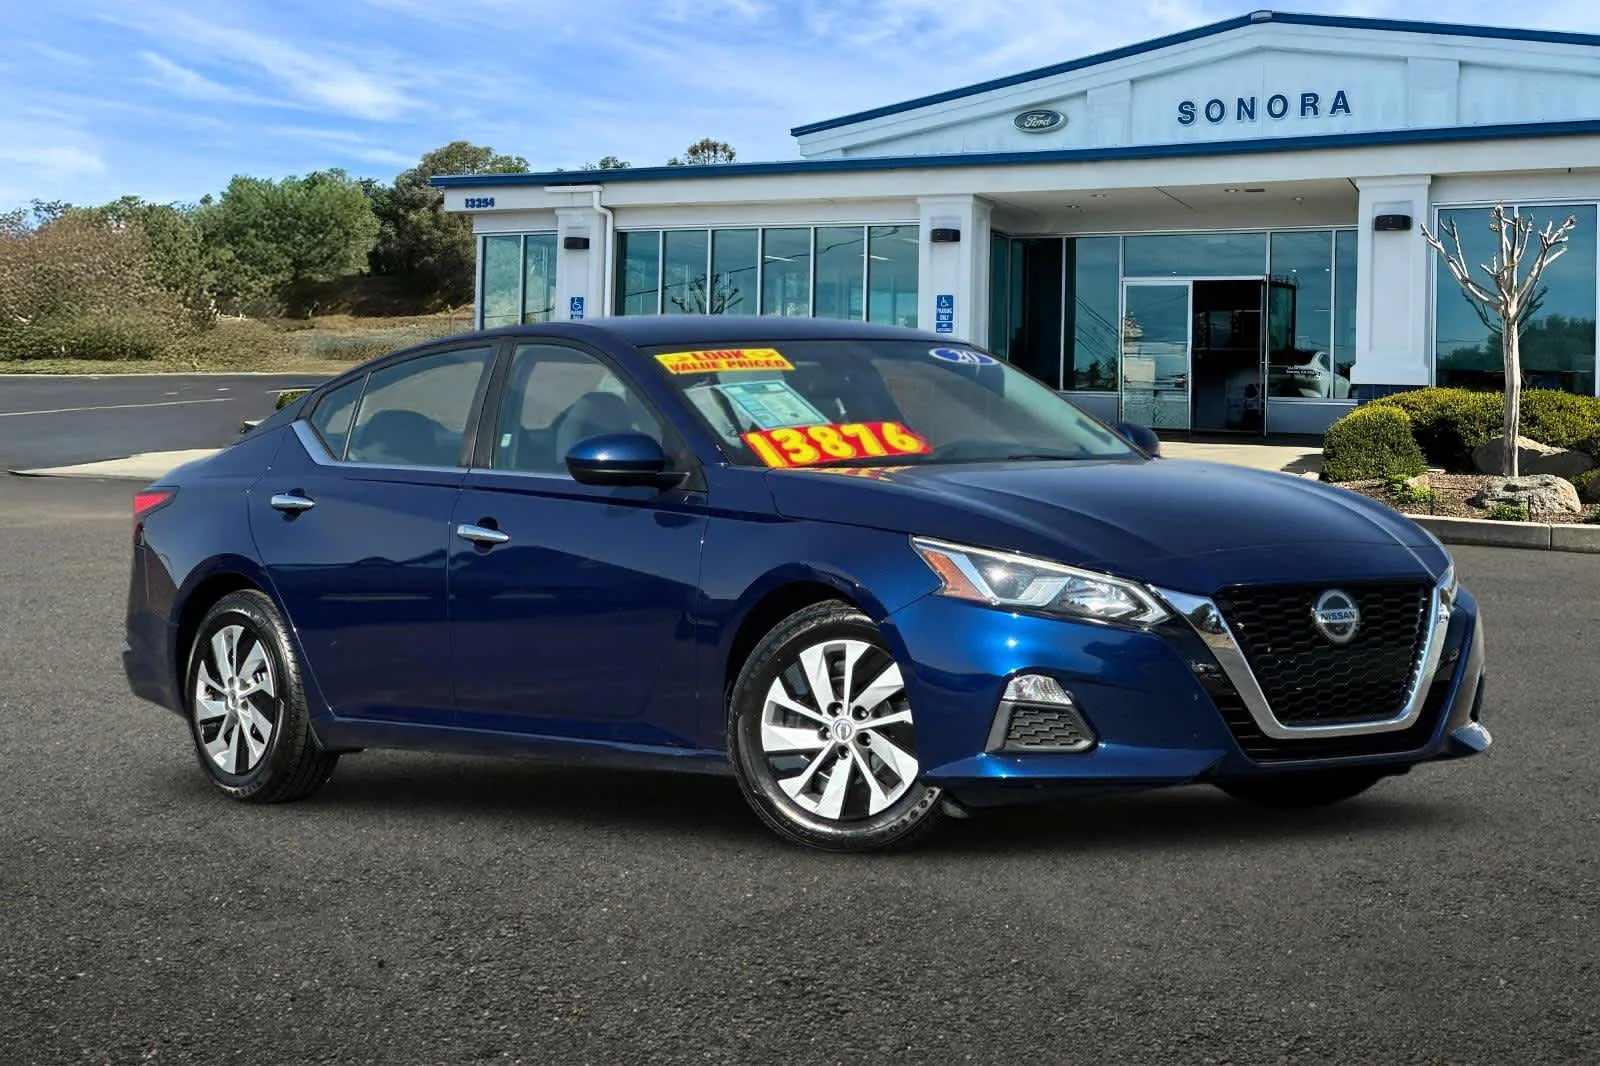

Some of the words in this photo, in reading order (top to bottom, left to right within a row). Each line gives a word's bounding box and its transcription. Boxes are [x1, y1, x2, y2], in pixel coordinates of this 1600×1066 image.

[1177, 90, 1352, 125] SONORA
[1024, 114, 1051, 128] Ford
[691, 350, 746, 361] LOOK
[669, 360, 721, 372] VALUE
[725, 359, 787, 369] PRICED
[746, 422, 921, 468] 13876
[1319, 610, 1356, 620] NISSAN
